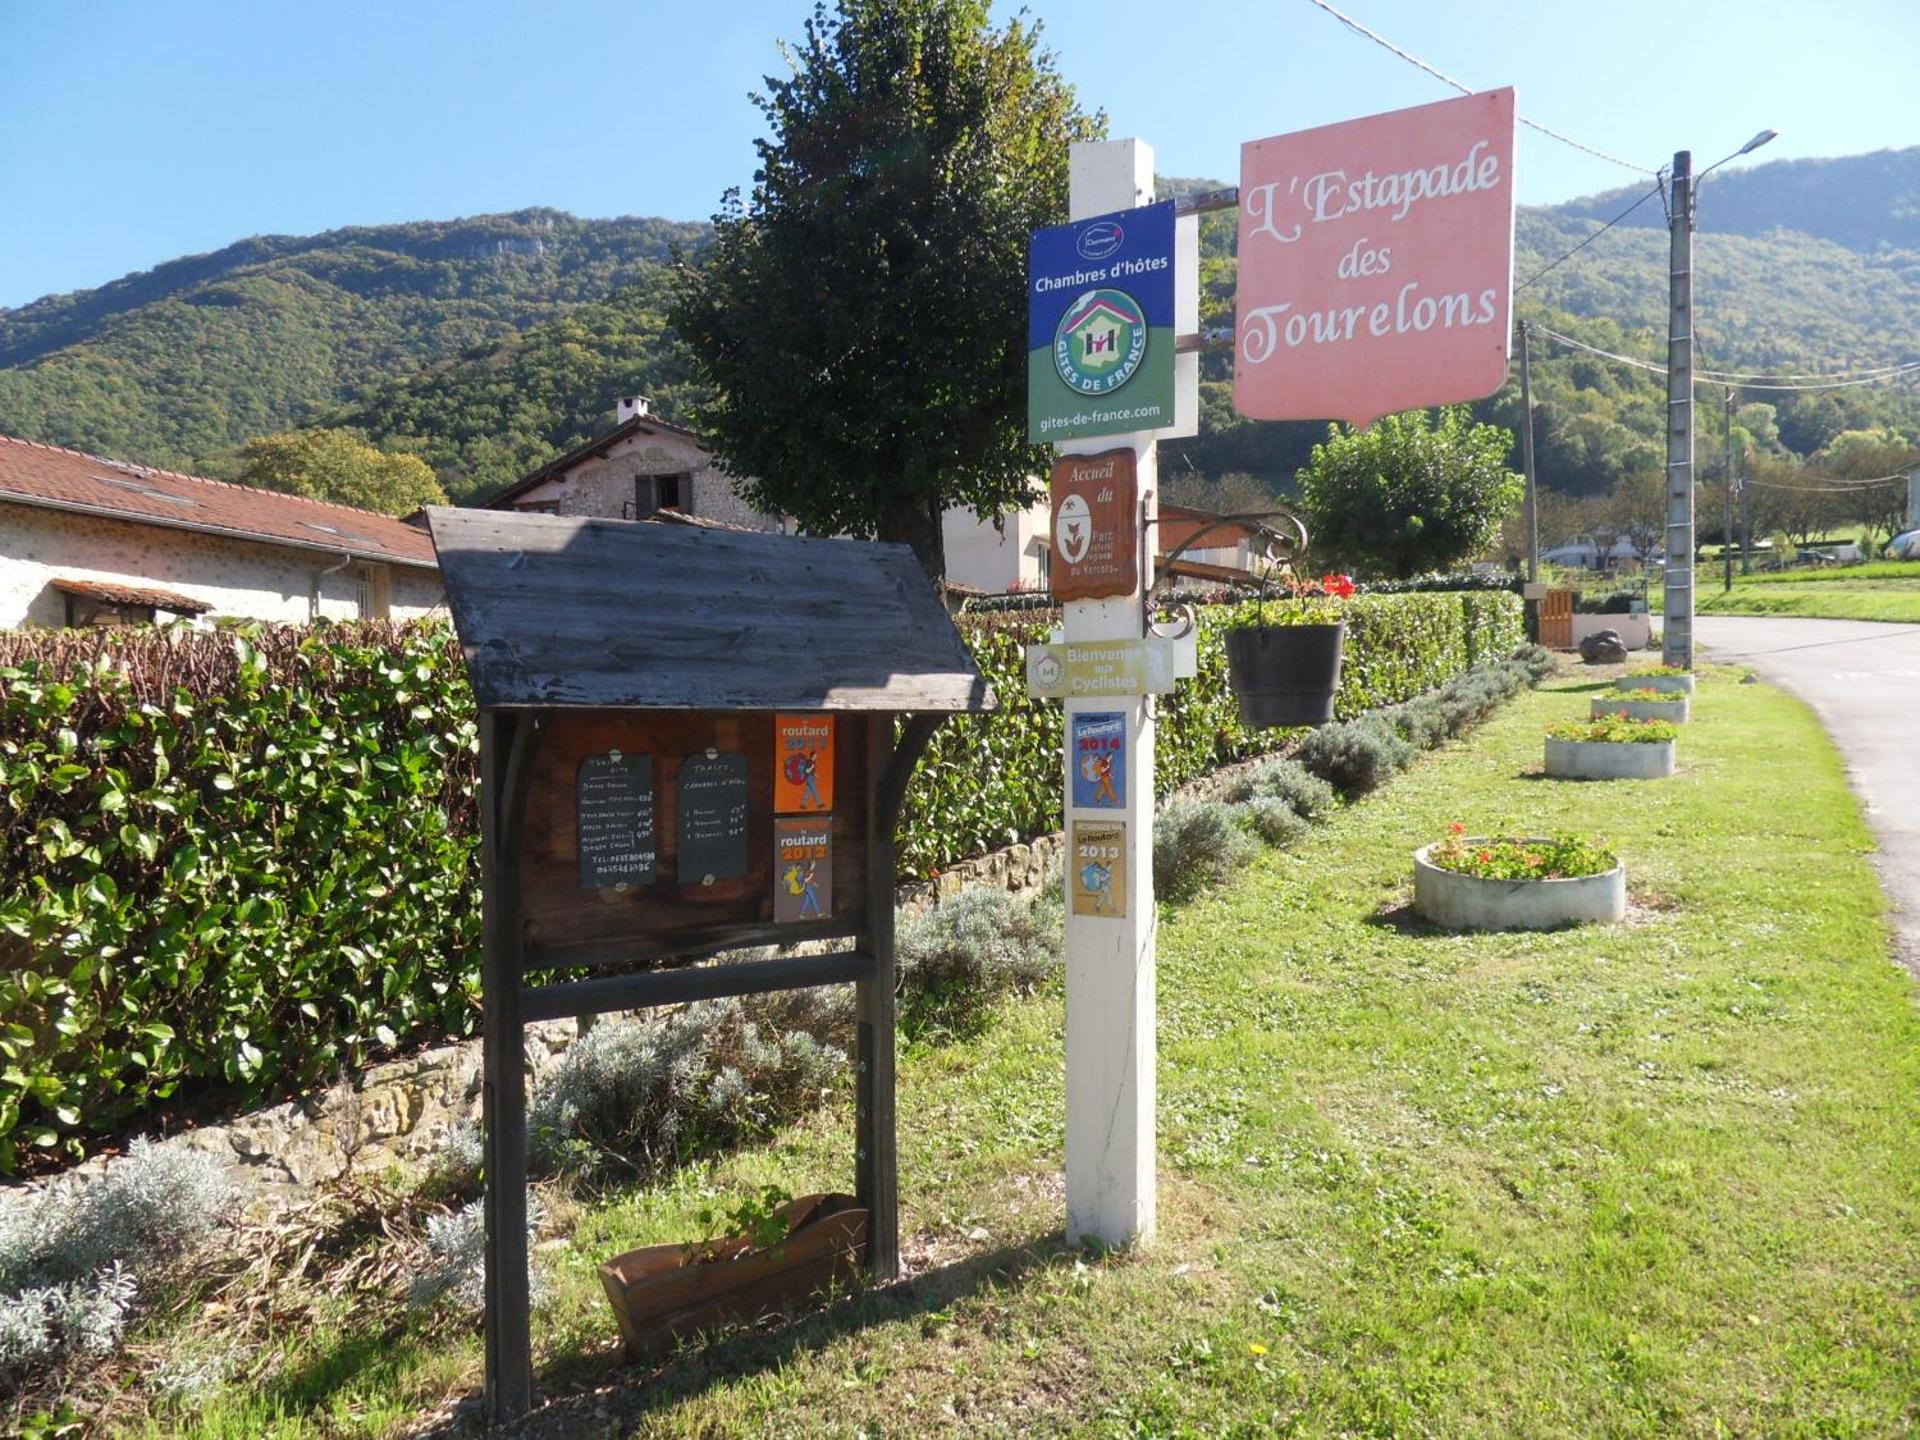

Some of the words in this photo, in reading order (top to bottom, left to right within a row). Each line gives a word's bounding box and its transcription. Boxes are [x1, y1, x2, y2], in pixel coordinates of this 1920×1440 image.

[1246, 141, 1500, 242] L'Estapade
[1338, 238, 1391, 279] des
[1035, 270, 1106, 292] Chambres
[1110, 256, 1168, 278] d'hôtes
[1242, 282, 1496, 363] Tourelons
[1082, 379, 1101, 391] DE
[1107, 327, 1142, 387] FRANCE
[1040, 405, 1161, 432] gites-de-france.com
[1070, 462, 1114, 481] Accueil
[1097, 488, 1113, 502] du
[1067, 648, 1142, 662] Bienvenue
[1072, 676, 1137, 691] Cyclistes
[782, 725, 828, 736] routard
[1088, 723, 1120, 735] Routard
[1079, 736, 1120, 750] 2014
[781, 834, 827, 846] routard
[1088, 832, 1120, 842] Routard
[1079, 845, 1119, 859] 2013
